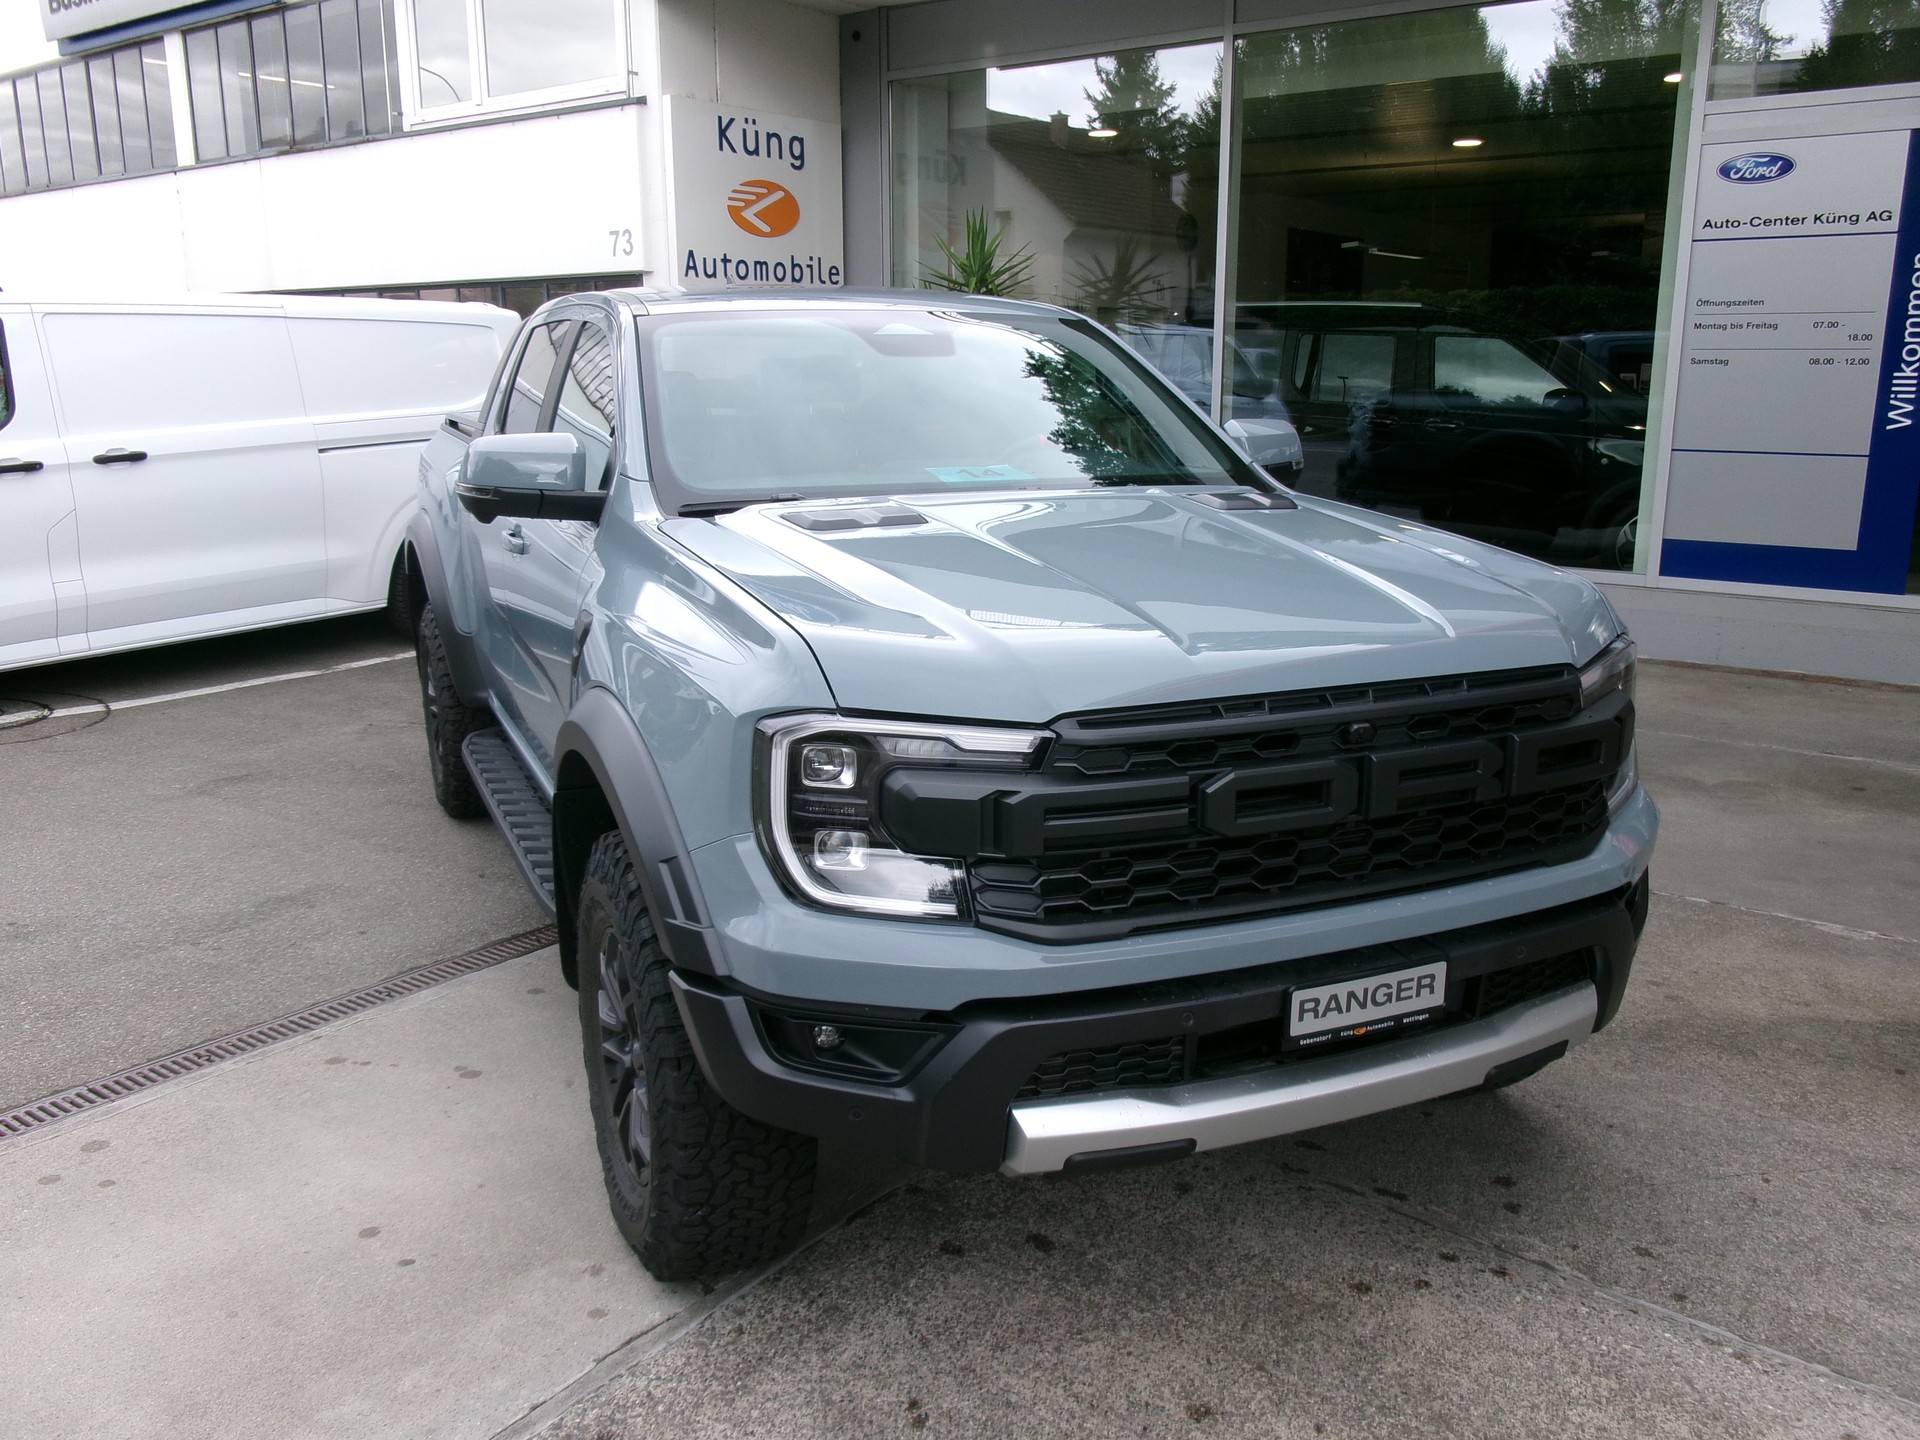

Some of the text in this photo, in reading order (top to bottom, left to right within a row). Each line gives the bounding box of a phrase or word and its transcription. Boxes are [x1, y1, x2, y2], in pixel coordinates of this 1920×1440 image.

[717, 115, 805, 171] Küng
[1730, 156, 1783, 180] Ford
[1702, 210, 1894, 230] Auto-Center Küng AG
[609, 229, 634, 257] 73
[684, 250, 841, 285] Automobile
[1696, 298, 1765, 308] Öffnungszeiten
[1693, 321, 1779, 331] Montag bis Freitag
[1812, 321, 1839, 329] 07.00
[1847, 334, 1873, 342] 18.00
[1690, 358, 1730, 367] Samstag
[1808, 358, 1835, 366] 08.00
[1844, 358, 1870, 366] 12.00
[1298, 973, 1436, 1022] RANGER
